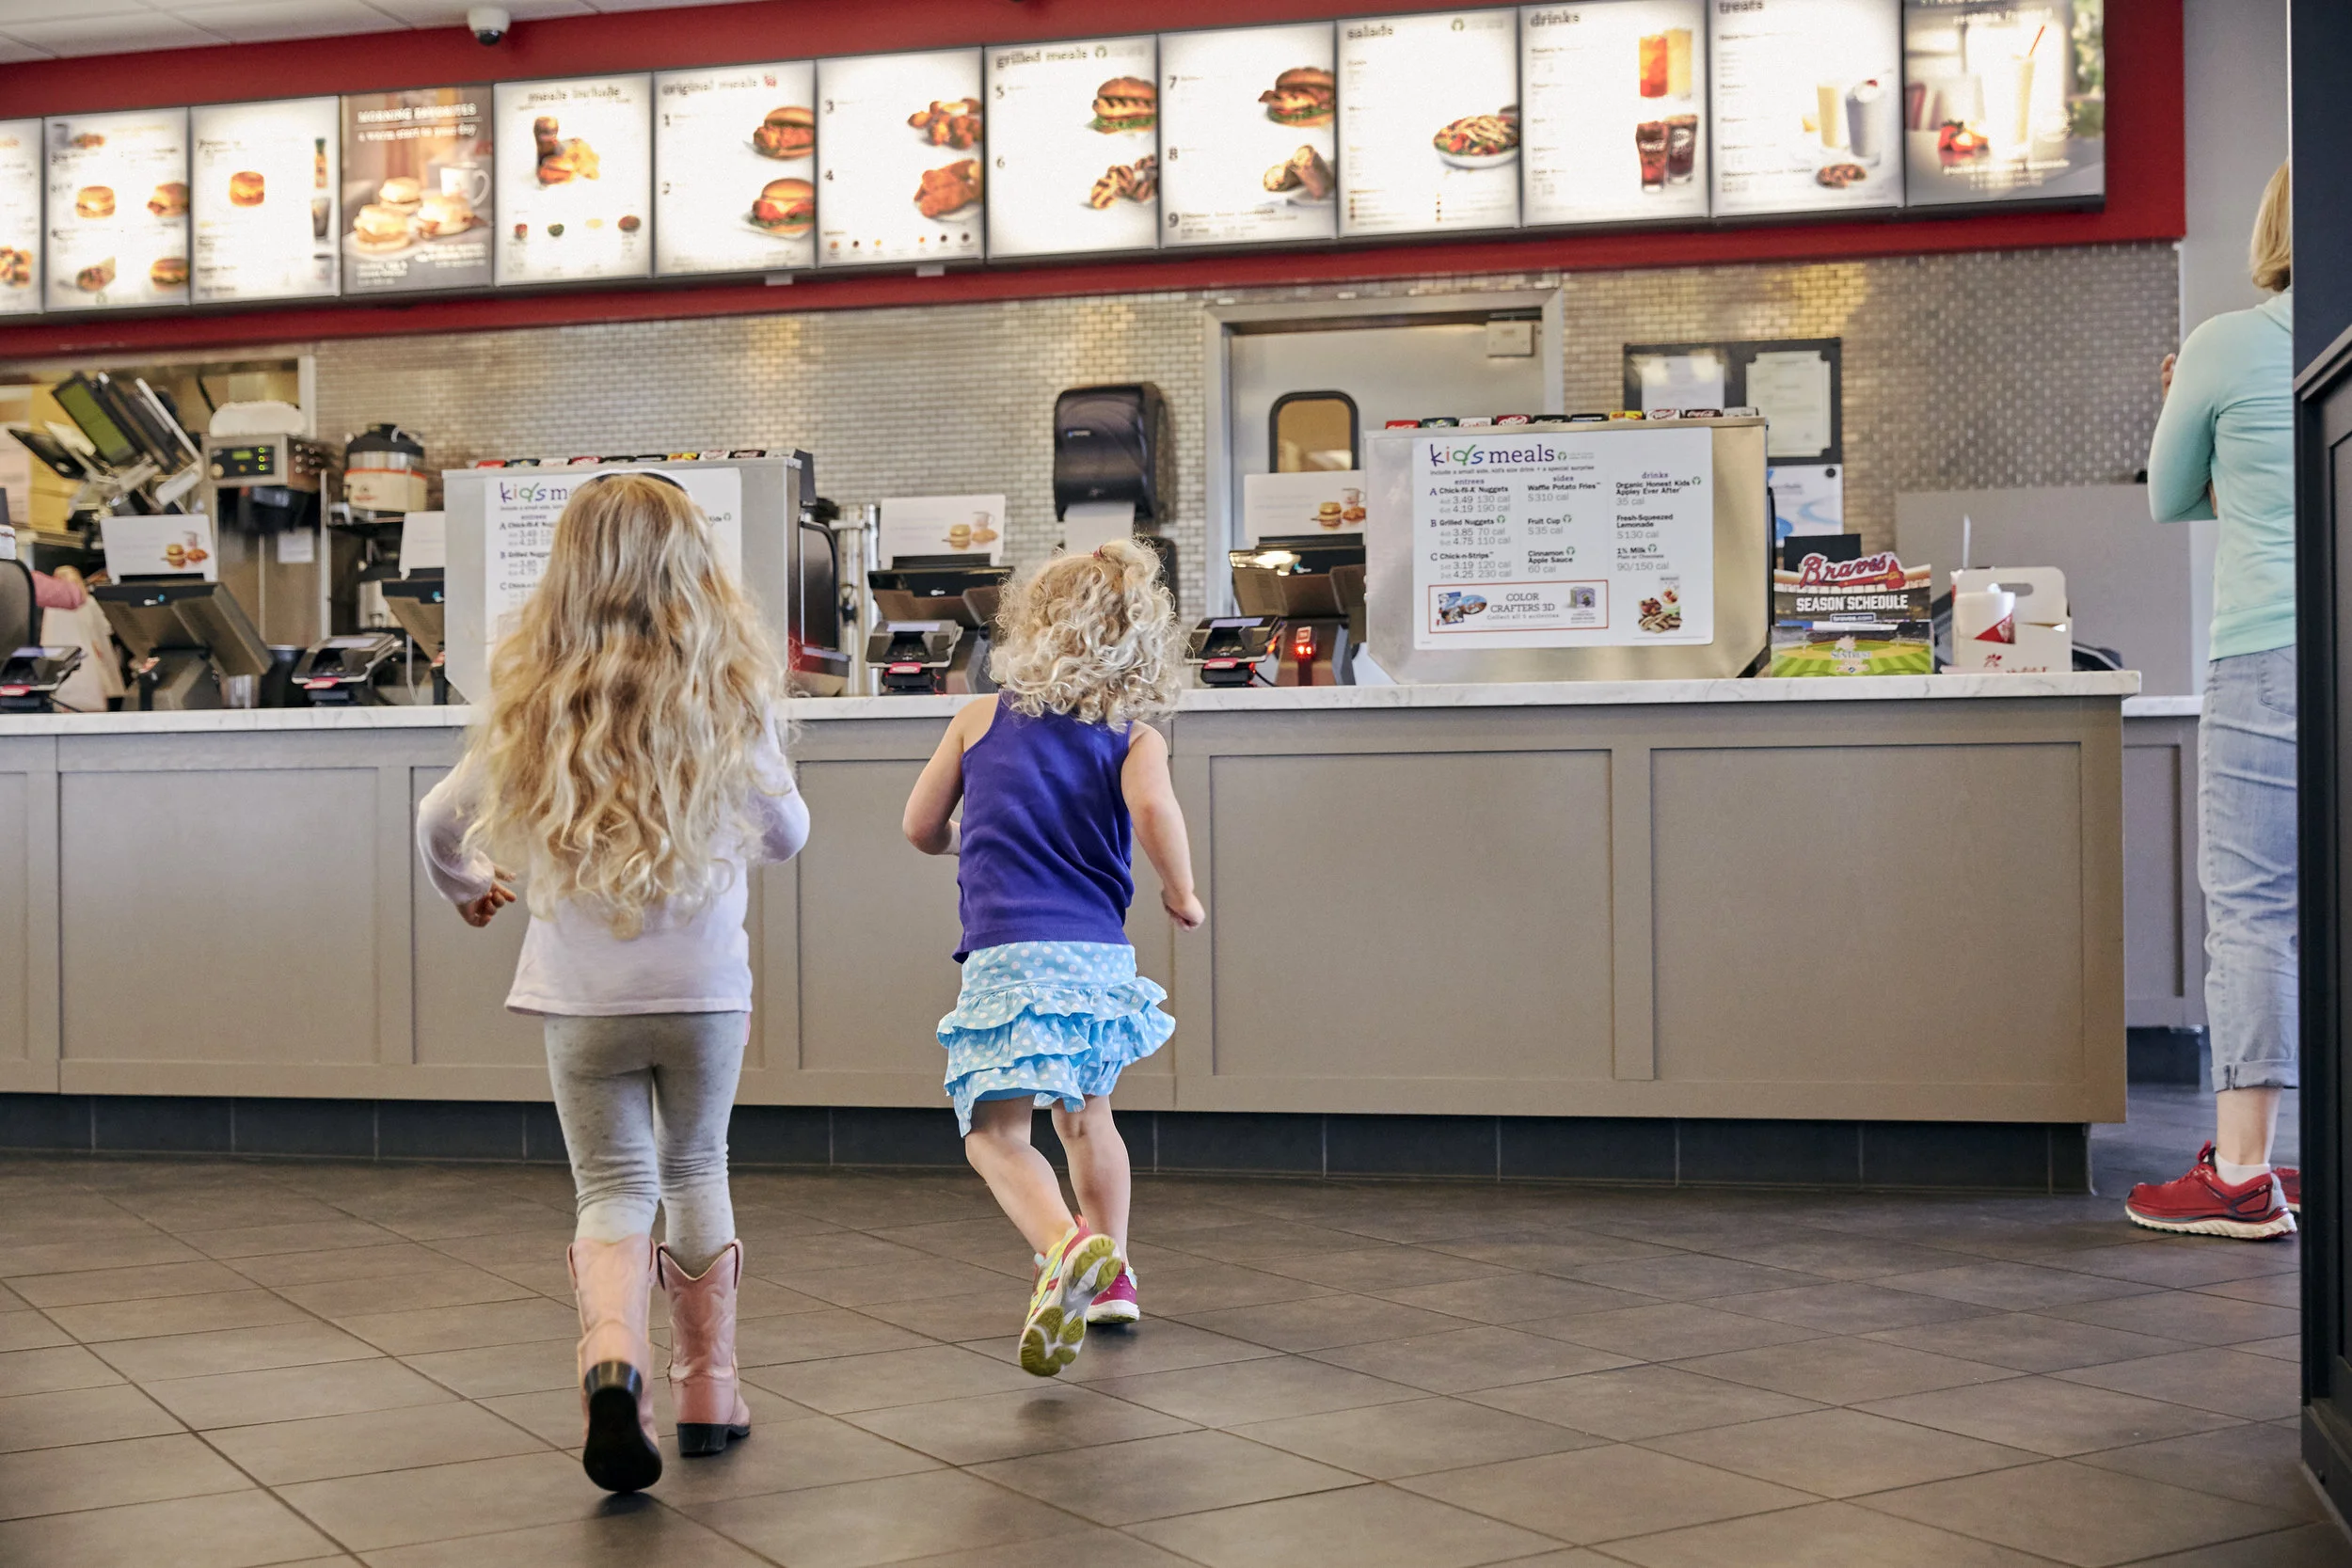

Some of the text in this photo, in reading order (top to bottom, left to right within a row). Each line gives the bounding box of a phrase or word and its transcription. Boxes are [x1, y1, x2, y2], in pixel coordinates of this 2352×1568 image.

[1719, 1, 1763, 14] treats
[1530, 9, 1580, 27] drinks
[1346, 24, 1393, 40] salads
[995, 50, 1041, 70] grilled
[1046, 46, 1088, 61] meals
[662, 75, 756, 96] original meals
[1168, 75, 1177, 89] 7
[528, 84, 620, 102] meals include
[995, 85, 1005, 99] 5
[1168, 148, 1178, 161] 8
[1168, 212, 1179, 228] 9
[1489, 444, 1555, 464] meals
[1430, 487, 1437, 496] A
[1453, 496, 1473, 504] 3.49
[1478, 495, 1495, 504] 130
[1497, 495, 1511, 503] cal
[1556, 493, 1569, 501] cal
[1616, 497, 1645, 506] 35 cal
[1453, 504, 1473, 513] 4.19
[1478, 504, 1495, 513] 190
[1497, 503, 1511, 512] cal
[500, 522, 506, 531] A
[1430, 519, 1437, 528] B
[1453, 528, 1473, 536] 3.85
[1477, 528, 1489, 536] 70
[1492, 527, 1505, 535] cal
[1453, 537, 1473, 546] 4.75
[1477, 536, 1495, 546] 110
[1498, 536, 1511, 545] cal
[1430, 553, 1438, 562] C
[1453, 562, 1473, 570] 3.19
[1478, 561, 1495, 569] 120
[1497, 561, 1511, 569] cal
[1528, 565, 1541, 574] 60
[1617, 561, 1669, 571] 90/150 cal
[1453, 570, 1474, 578] 4.25
[1478, 570, 1496, 578] 230
[1499, 569, 1512, 578] cal
[1800, 553, 1886, 589] Braves
[500, 582, 507, 591] C
[1506, 593, 1539, 601] COLOR
[1796, 594, 1909, 612] SEASON SCHEDULE
[1490, 604, 1542, 613] CRAFTERS
